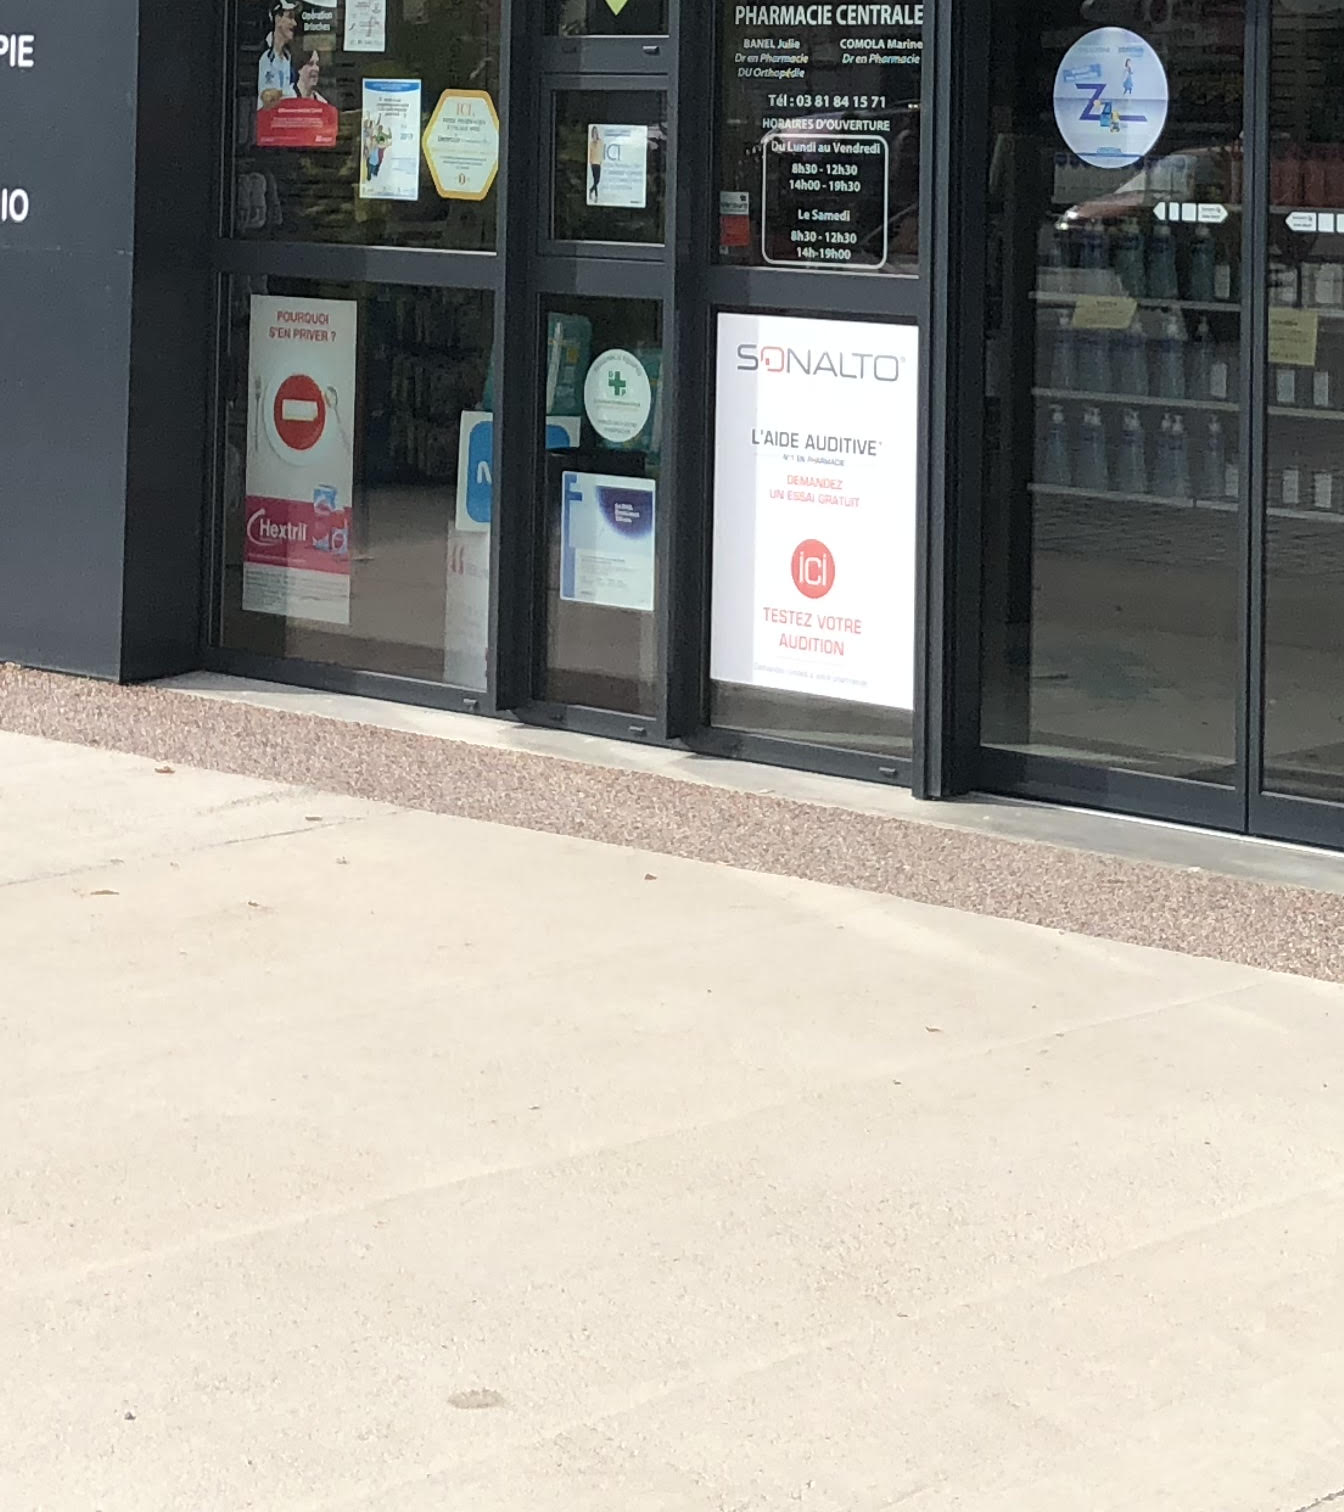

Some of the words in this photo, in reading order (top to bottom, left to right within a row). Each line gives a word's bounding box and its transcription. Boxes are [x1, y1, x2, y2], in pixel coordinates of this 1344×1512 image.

[735, 4, 832, 25] PHARMACIE
[836, 4, 924, 25] CENTRALE
[743, 39, 775, 49] BANEL
[777, 39, 800, 49] Julie
[840, 39, 885, 49] COMOLA
[887, 39, 923, 49] Marine
[759, 53, 808, 64] Pharmacie
[842, 53, 854, 64] Dr
[855, 55, 867, 64] en
[868, 53, 920, 64] Pharmacie
[768, 94, 787, 107] Tél
[796, 95, 812, 107] 03
[814, 95, 829, 108] 81
[833, 95, 849, 108] 84
[853, 96, 868, 108] 15
[871, 96, 885, 108] 71
[763, 118, 814, 130] HORAIRES
[817, 118, 890, 131] D'OUVERTURE
[771, 141, 785, 152] Du
[787, 141, 816, 153] Lundi
[818, 144, 830, 153] au
[833, 142, 880, 154] Vendredi
[792, 163, 817, 174] 8h30
[826, 164, 858, 175] 12h30
[789, 179, 821, 191] 14h00
[829, 180, 861, 192] 19h30
[798, 209, 810, 220] Le
[812, 209, 850, 222] Samedi
[791, 230, 816, 241] 8h30
[825, 232, 857, 244] 12h30
[277, 311, 329, 325] POURQUOI
[293, 329, 328, 342] PRIVER
[737, 344, 899, 382] SONALTO
[751, 429, 799, 448] L'AIDE
[787, 474, 843, 490] DEMANDEZ
[769, 489, 784, 500] UN
[787, 490, 814, 503] ESSAI
[818, 494, 860, 507] GRATUIT
[259, 518, 307, 541] Hextril
[763, 607, 812, 627] TESTEZ
[817, 614, 862, 635] VOTRE
[779, 633, 844, 656] AUDITION
